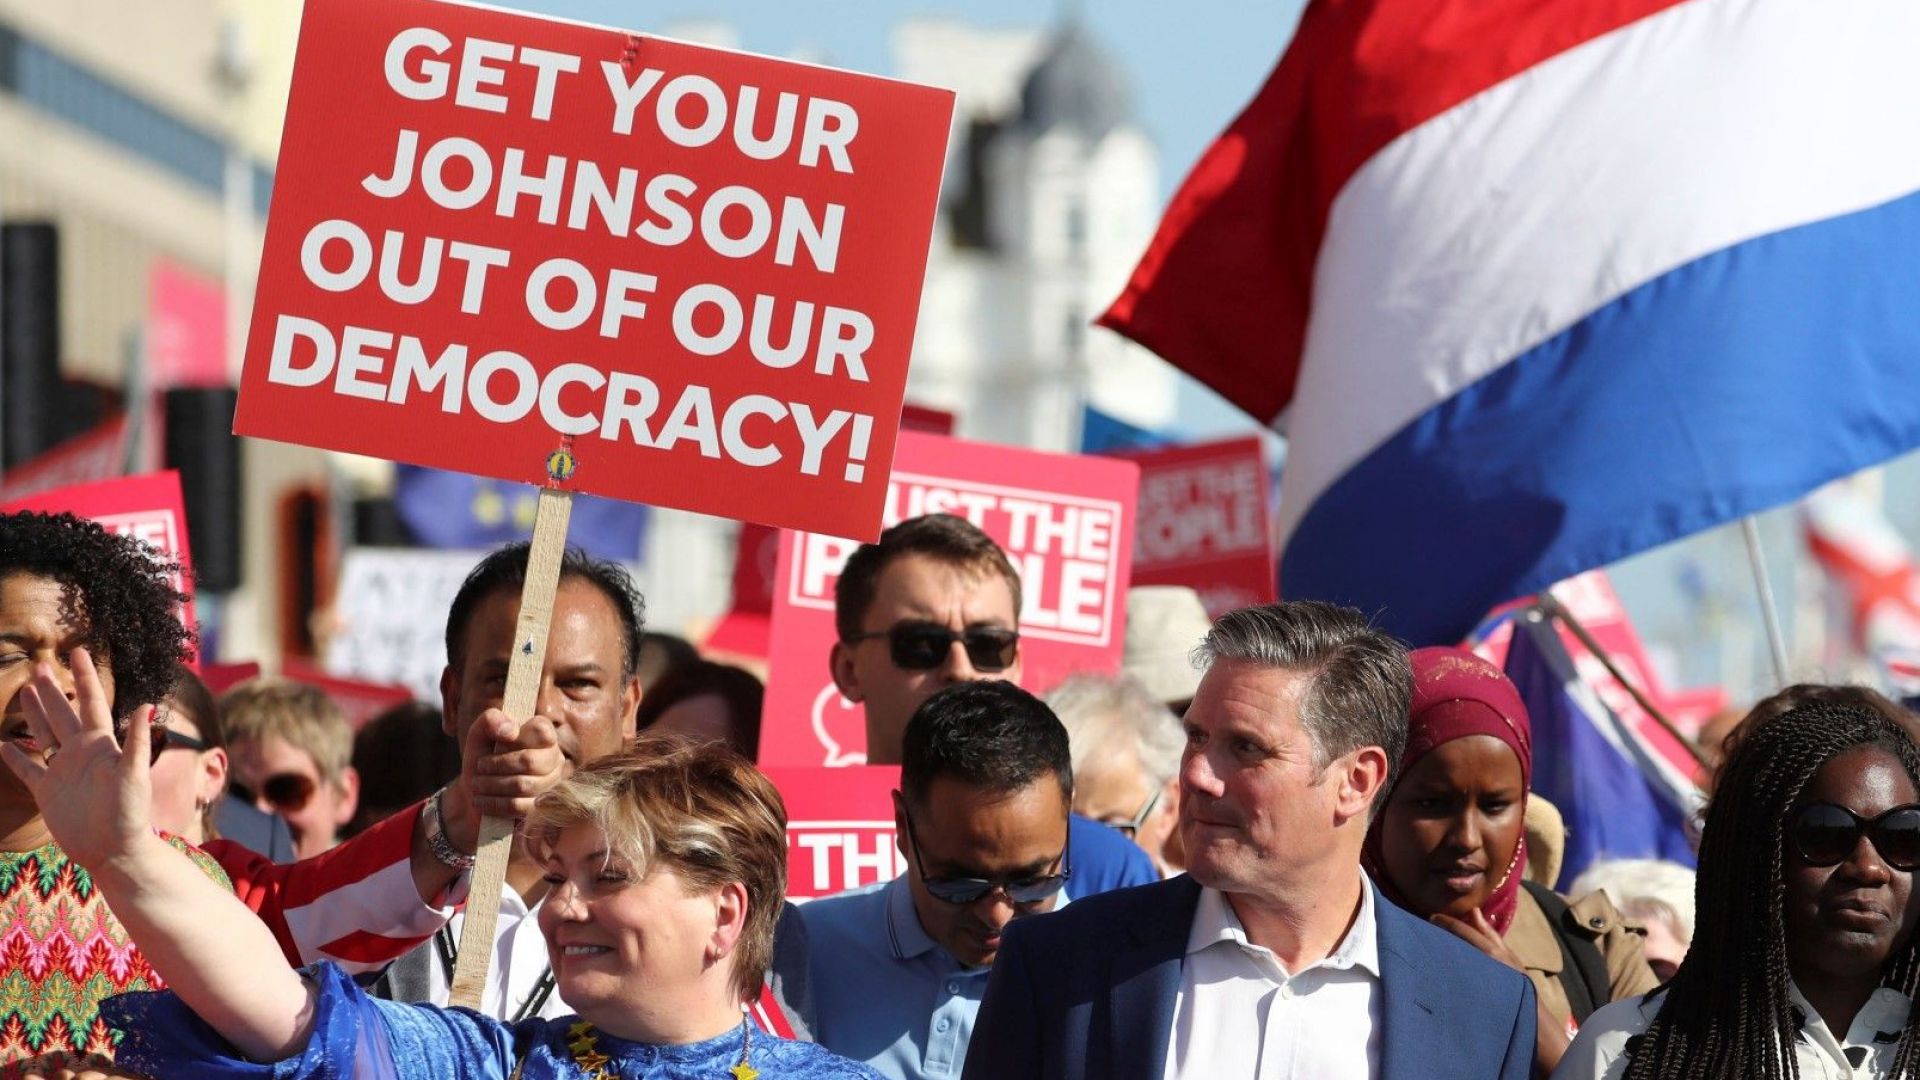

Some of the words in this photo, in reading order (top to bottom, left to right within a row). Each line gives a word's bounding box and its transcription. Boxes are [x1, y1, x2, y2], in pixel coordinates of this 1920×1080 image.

[384, 27, 582, 121] GET
[600, 60, 859, 174] YOUR
[361, 129, 846, 274] JOHNSON
[300, 219, 511, 315] OUT
[525, 258, 658, 339] OF
[672, 283, 875, 382] OUR
[268, 314, 874, 483] DEMOCRACY!
[802, 530, 1108, 634] PLE
[882, 483, 997, 529] UST
[1002, 497, 1112, 560] THE
[797, 832, 908, 891] TH
